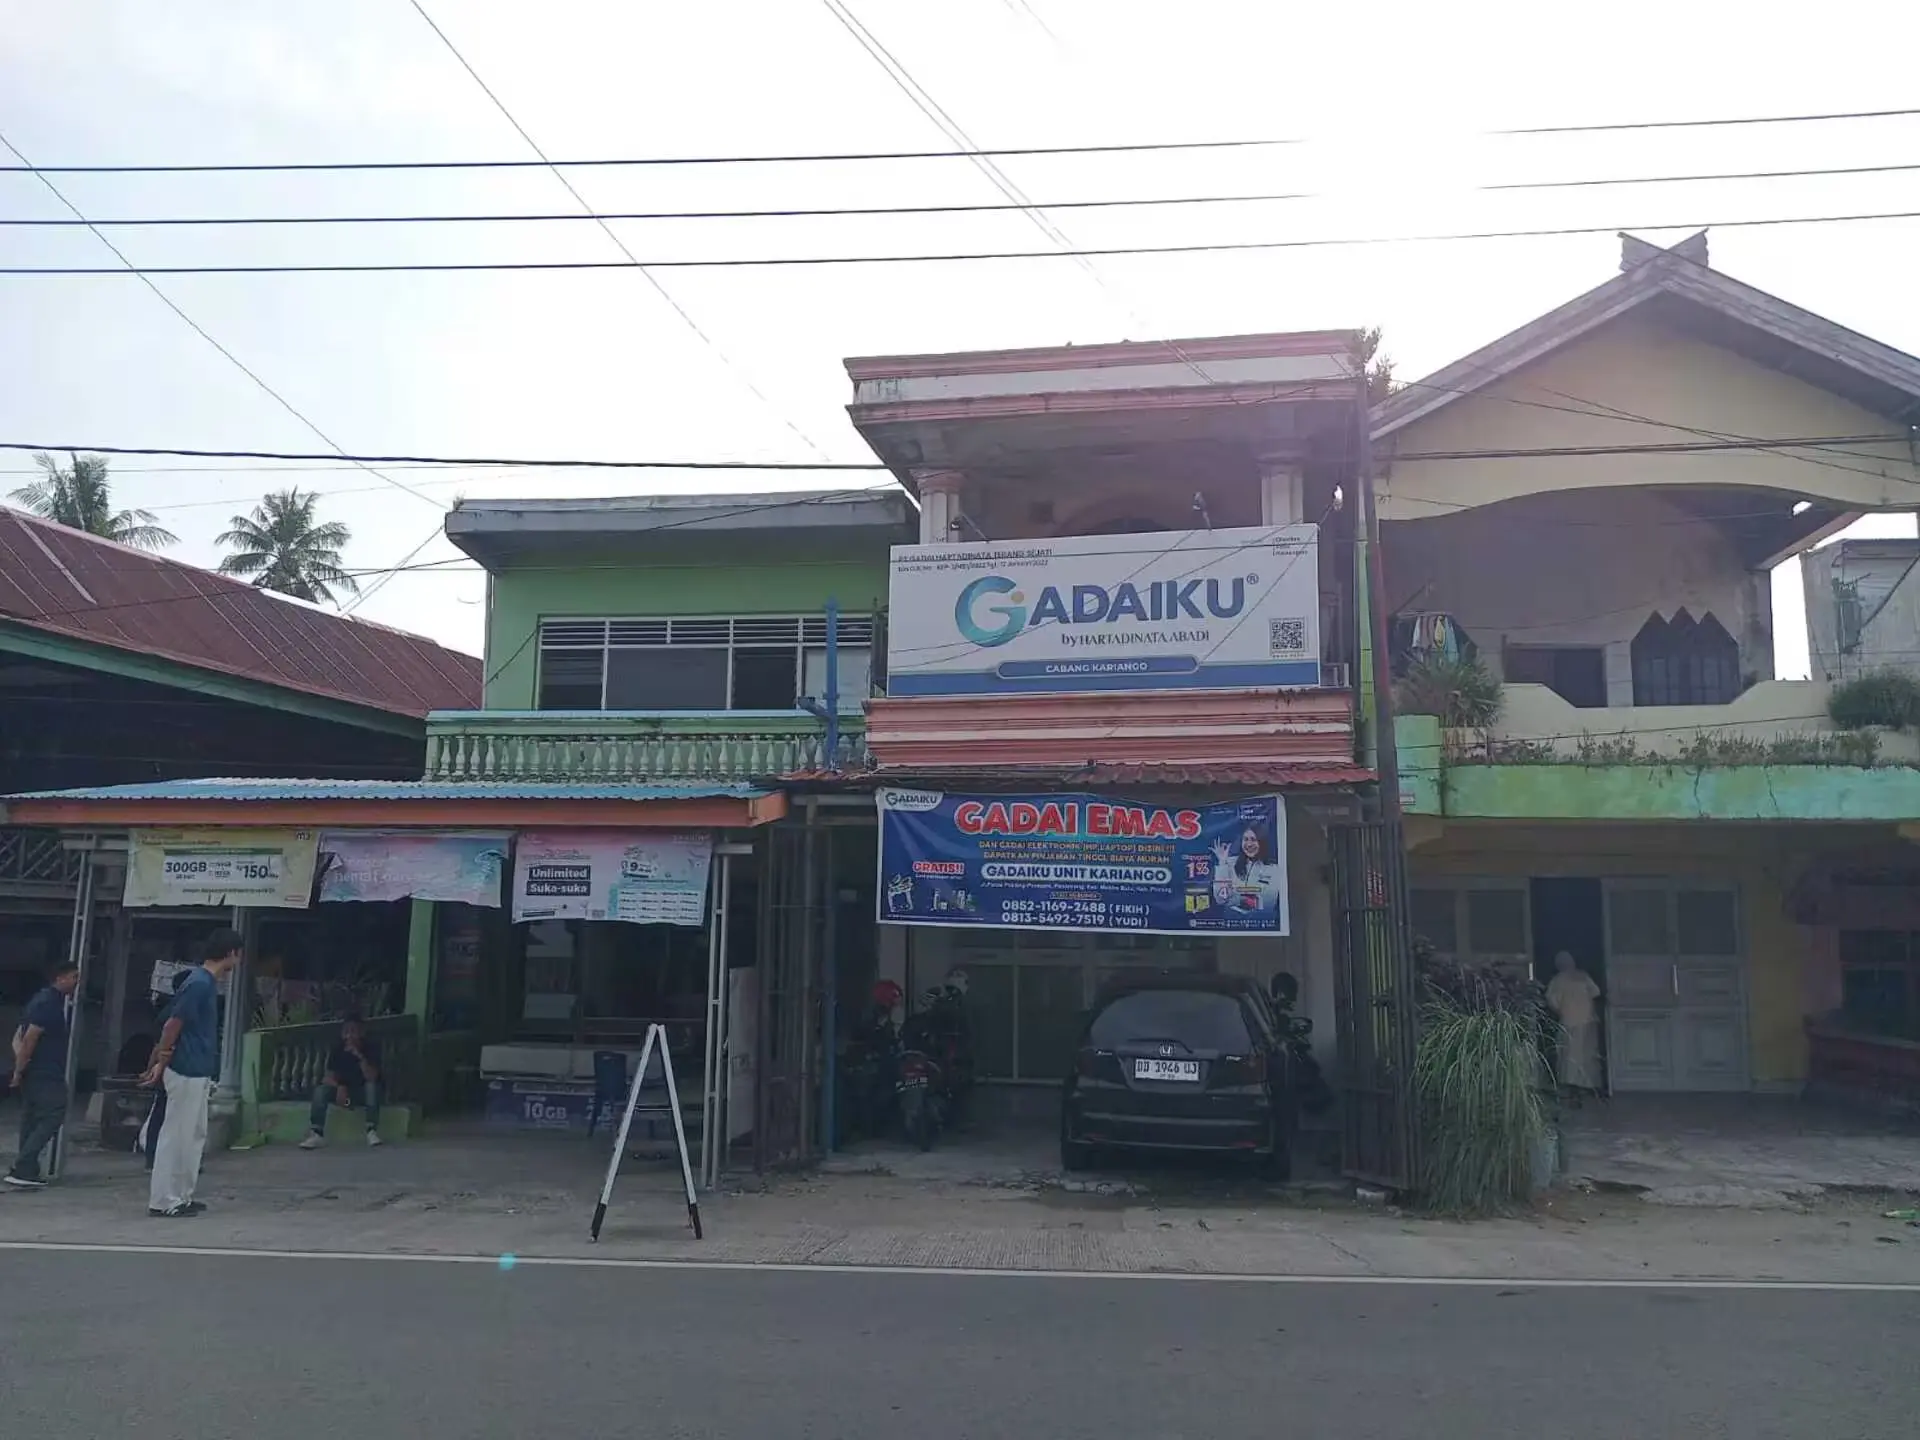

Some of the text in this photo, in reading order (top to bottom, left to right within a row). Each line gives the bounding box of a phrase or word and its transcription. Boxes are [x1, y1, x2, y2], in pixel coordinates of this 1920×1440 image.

[955, 575, 1244, 648] GADAIKU
[1061, 629, 1210, 647] by HARTADINATA ABADI
[1046, 661, 1148, 674] CABANG KARIANGO
[954, 801, 1079, 836] GADAI
[1085, 802, 1202, 840] EMAS
[165, 861, 207, 873] 300GB
[531, 866, 588, 879] Unlimited
[912, 862, 965, 874] GRATIS!!
[986, 865, 1167, 882] GADAIKU UNIT KARIANGO
[1186, 862, 1210, 879] 1%
[529, 881, 588, 894] Suka-suka
[1002, 899, 1106, 913] 0852-1169-2488
[1001, 912, 1105, 925] 0813-5492-7519
